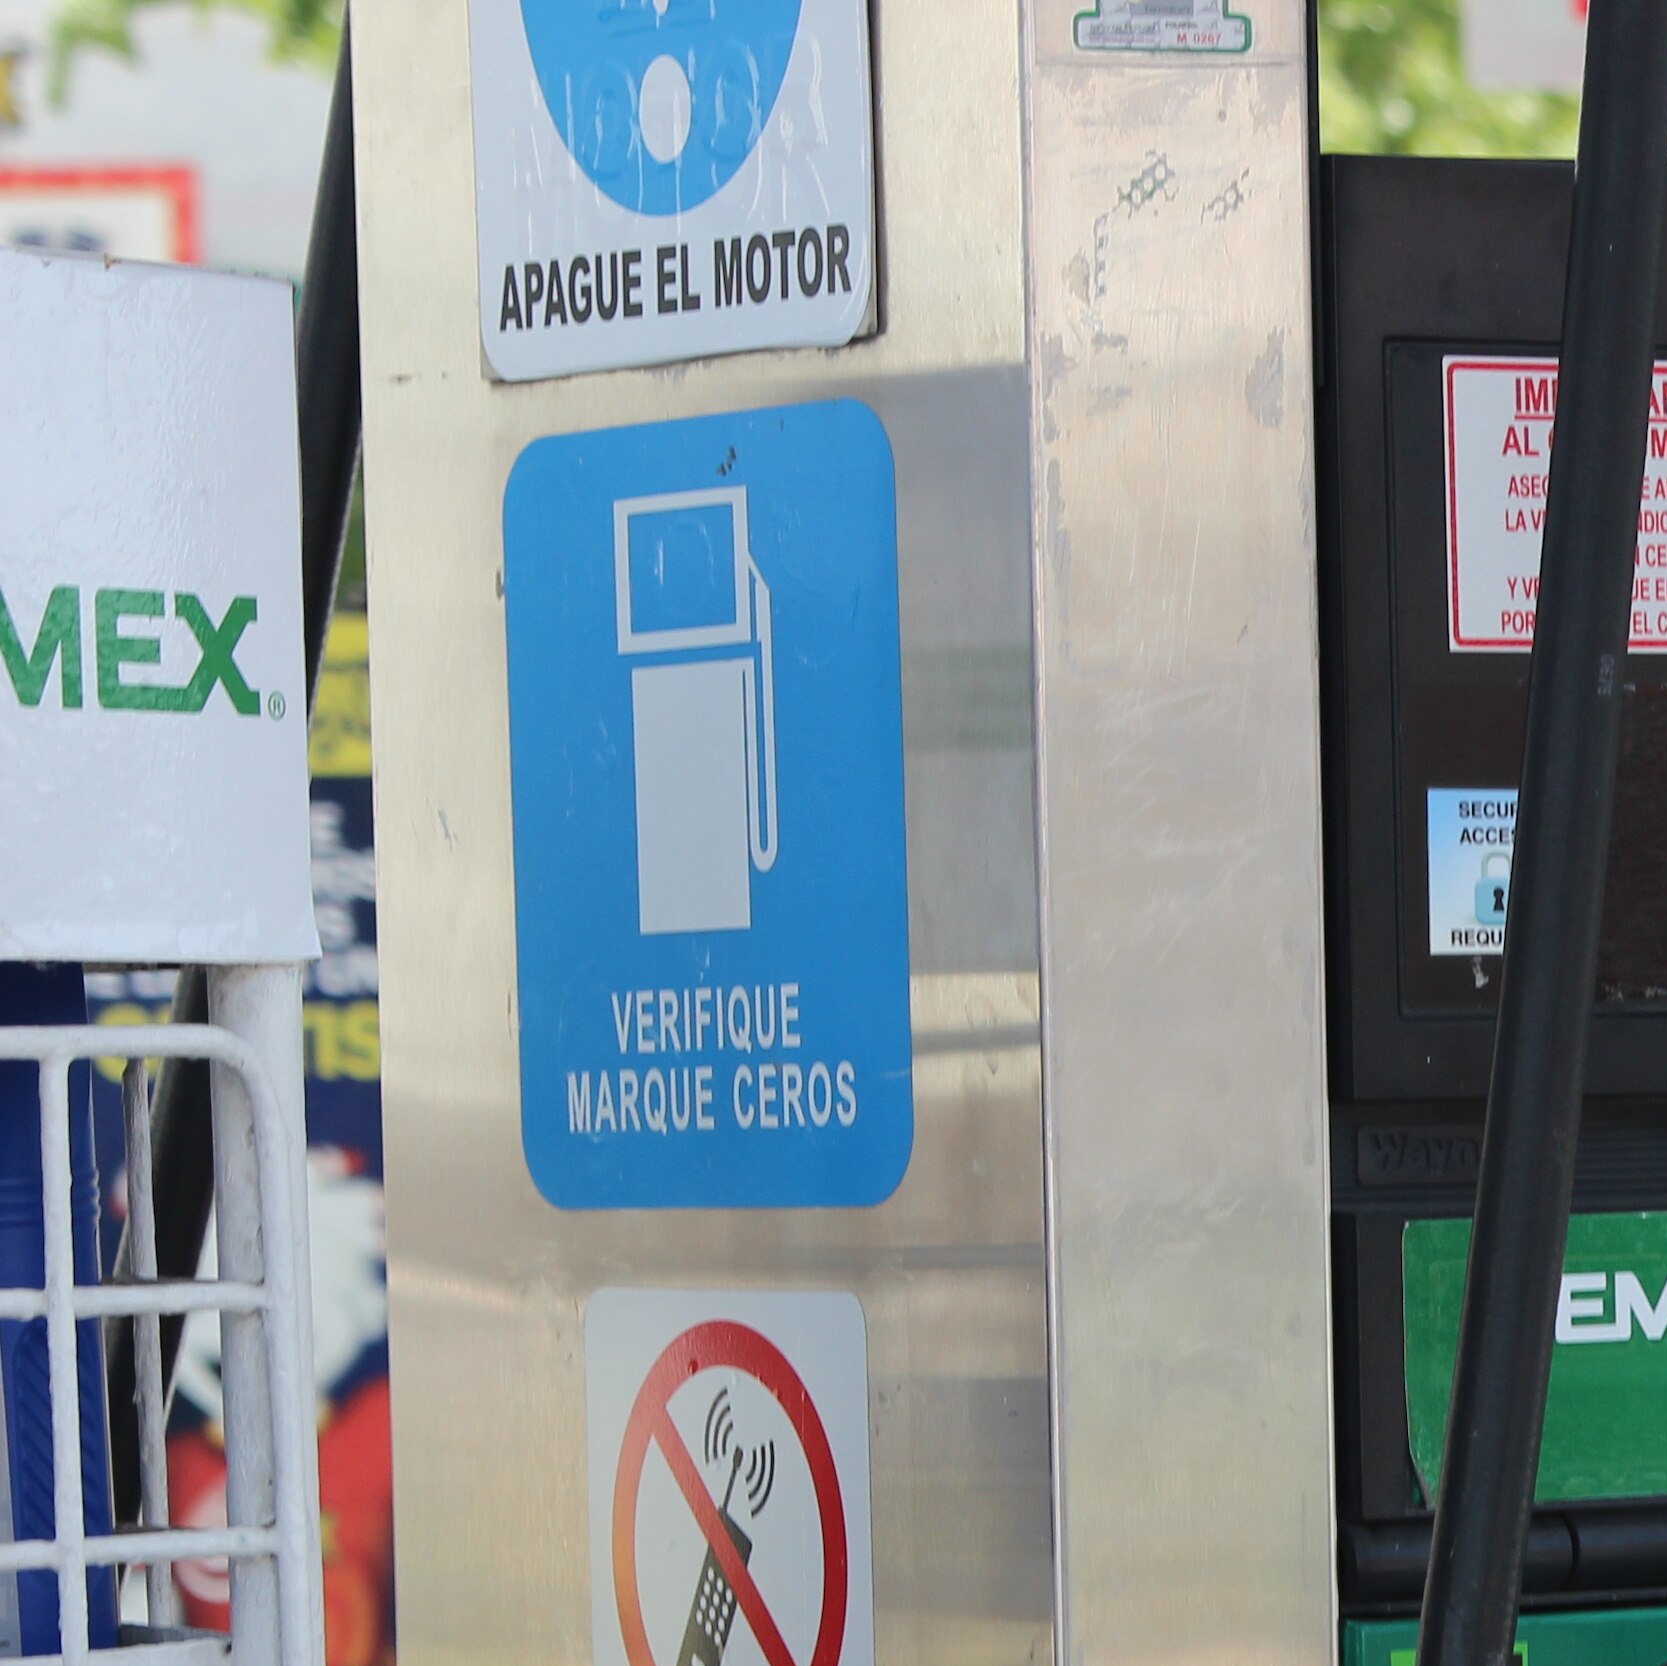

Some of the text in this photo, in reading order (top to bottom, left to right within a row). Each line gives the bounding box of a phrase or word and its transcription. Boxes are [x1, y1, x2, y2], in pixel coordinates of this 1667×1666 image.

[499, 222, 853, 334] APAGUE EL MOTOR
[1502, 426, 1540, 458] AL
[1505, 509, 1527, 532] LA
[1507, 577, 1518, 601] Y
[1633, 612, 1653, 635] EL
[611, 982, 802, 1056] VERIFIQUE
[566, 1061, 859, 1137] MARQUE CEROS
